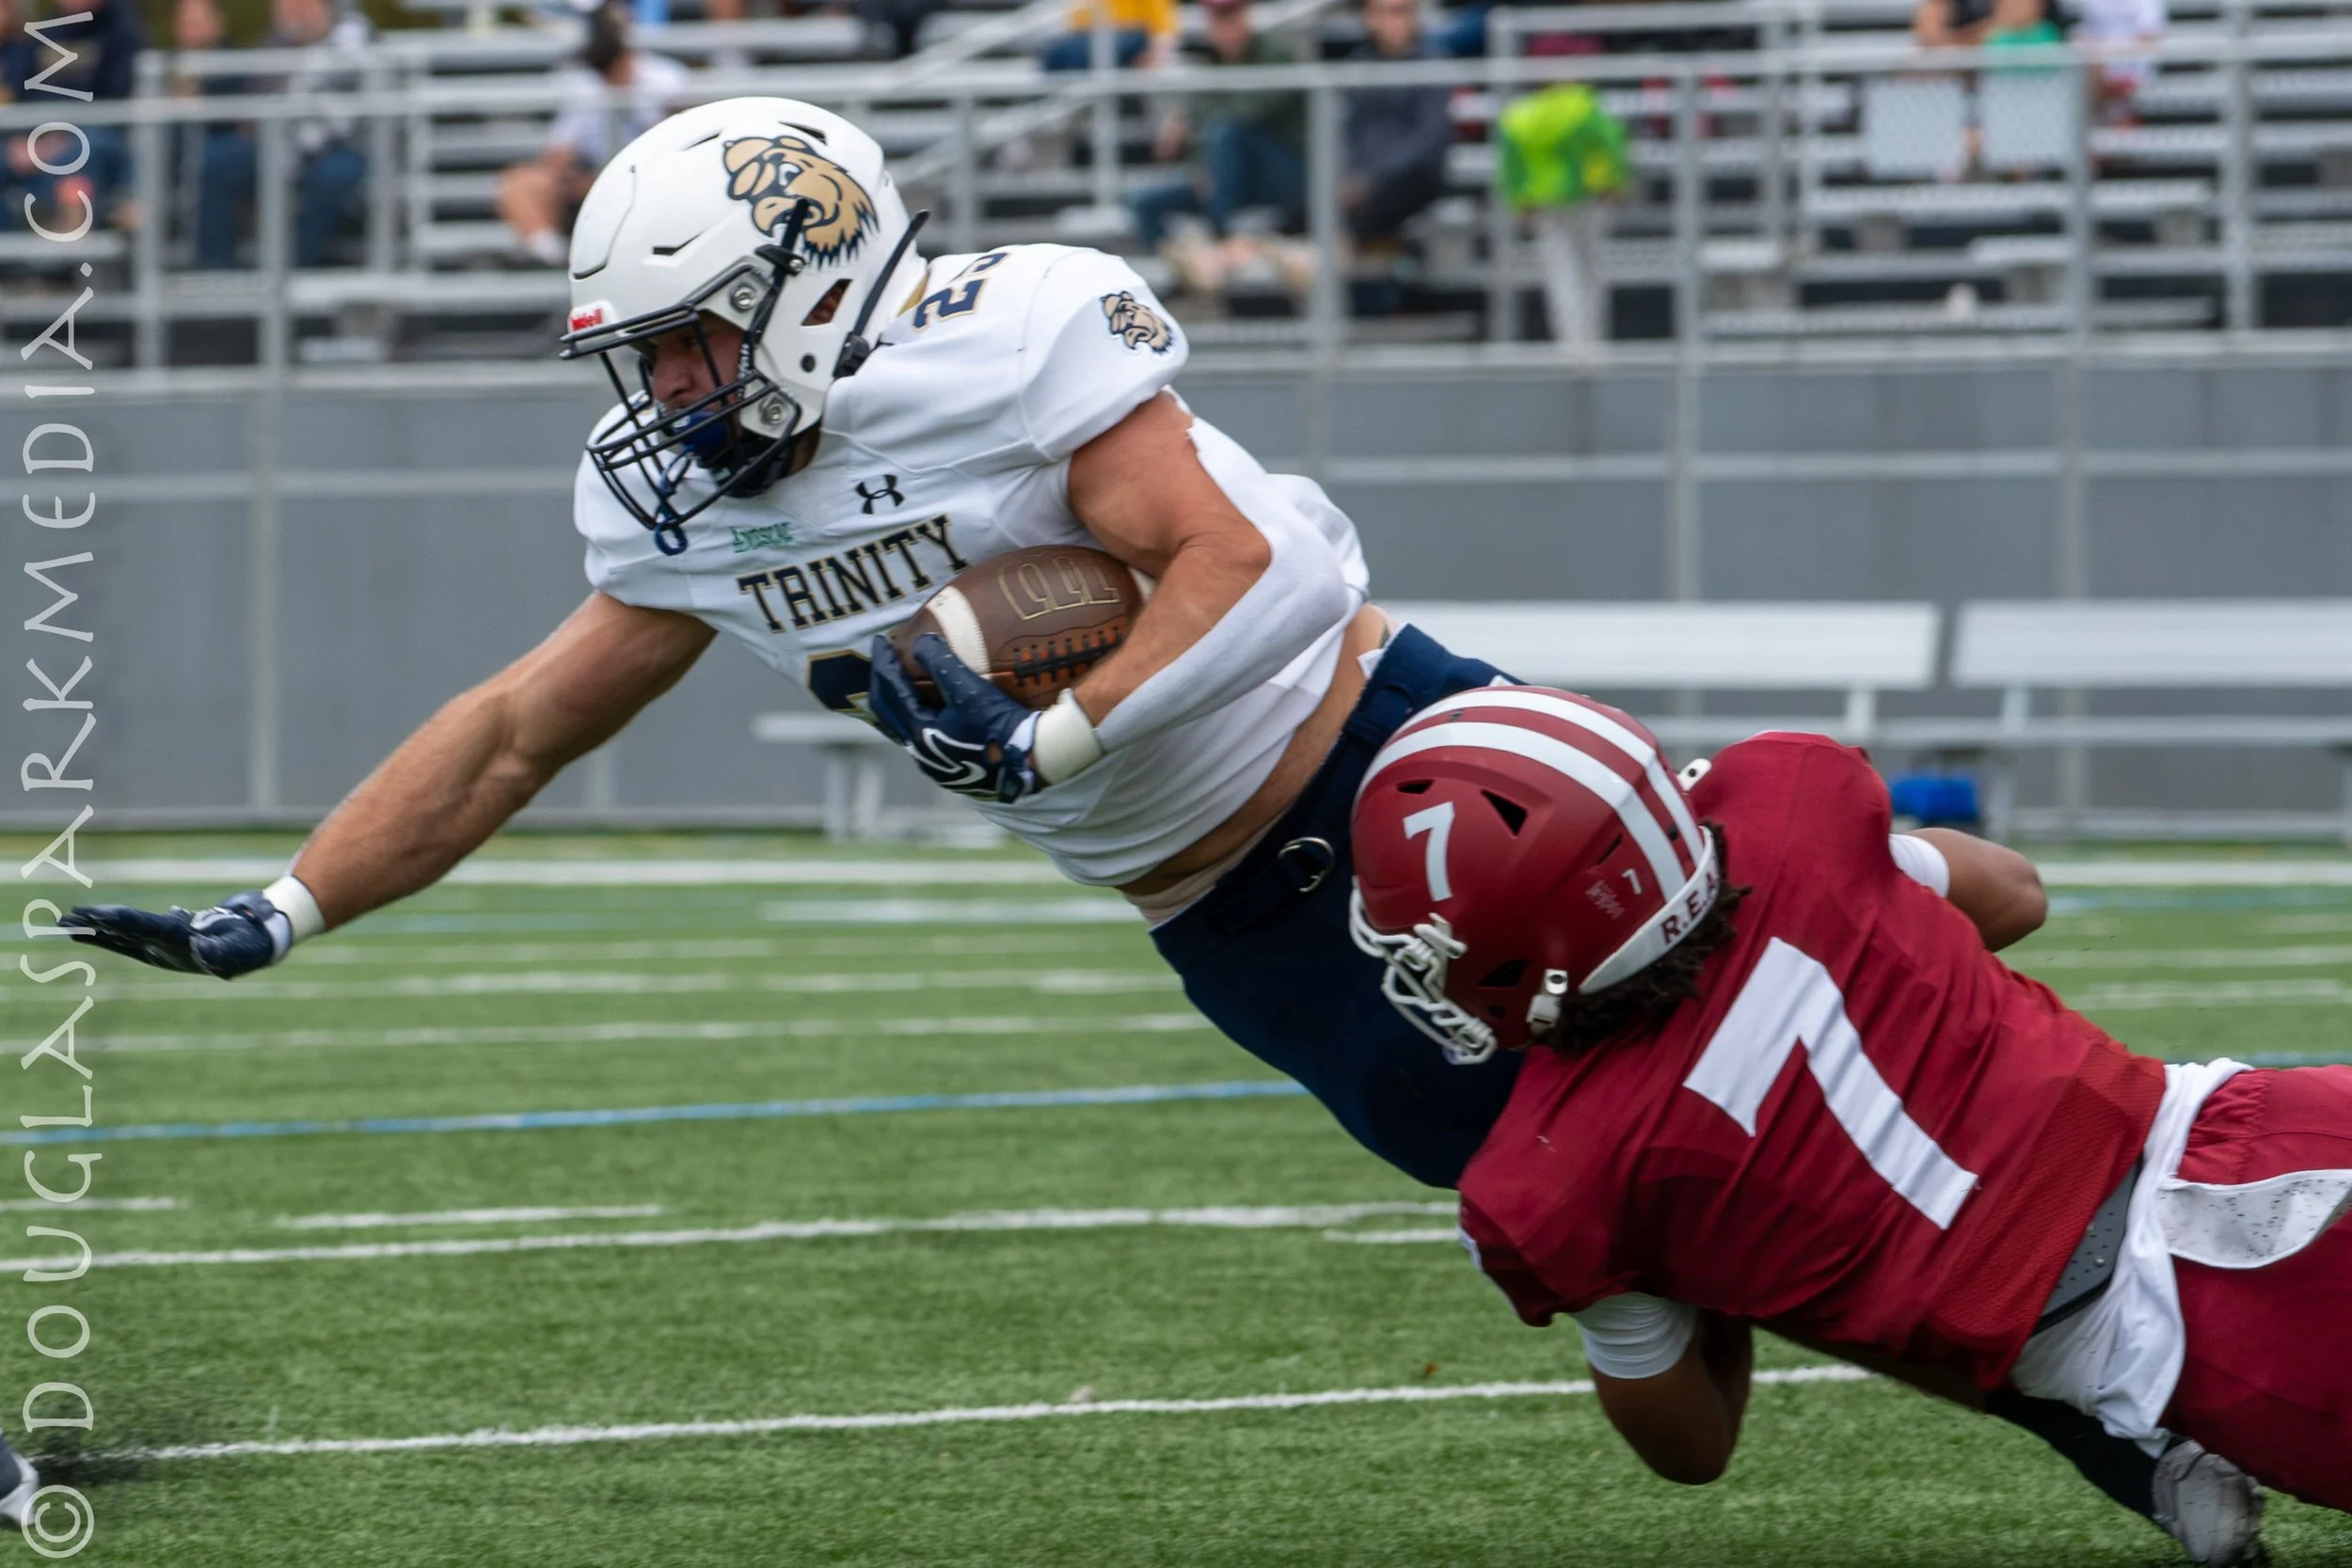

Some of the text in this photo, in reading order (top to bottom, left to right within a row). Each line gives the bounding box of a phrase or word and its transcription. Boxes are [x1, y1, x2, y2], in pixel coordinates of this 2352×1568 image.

[735, 514, 970, 634] TRINITY
[1403, 801, 1455, 903] 7
[1683, 936, 1979, 1230] 7
